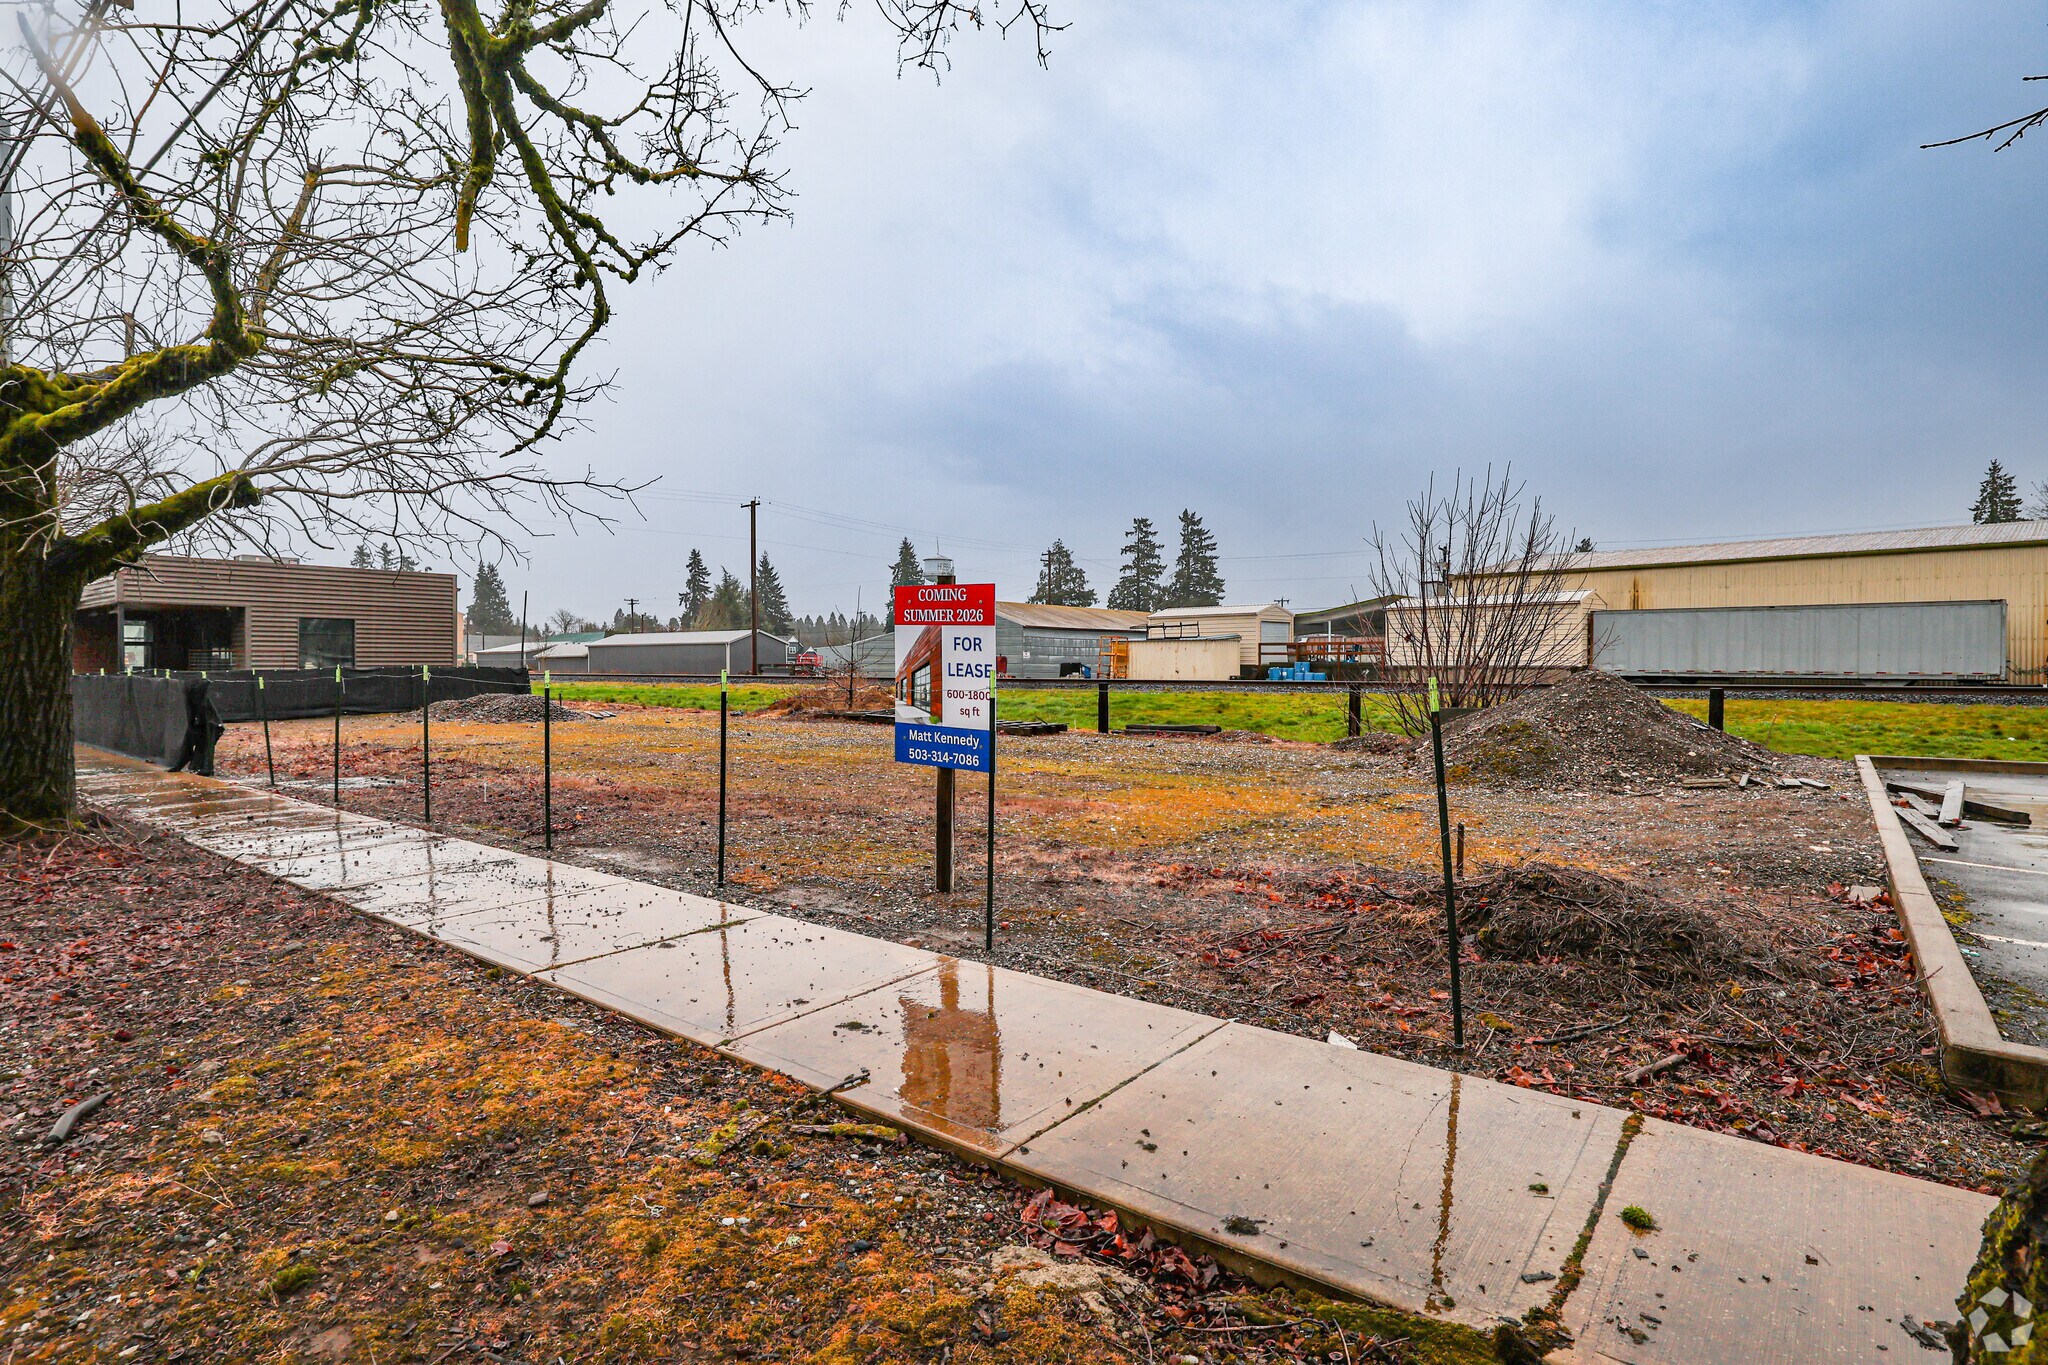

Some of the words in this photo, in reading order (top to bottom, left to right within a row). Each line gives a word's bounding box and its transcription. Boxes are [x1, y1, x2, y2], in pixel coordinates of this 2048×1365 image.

[918, 588, 967, 601] COMING
[903, 609, 955, 622] SUMMER
[956, 608, 984, 622] 2026
[953, 637, 982, 651] FOR
[948, 662, 993, 678] LEASE
[959, 707, 970, 718] sq
[972, 706, 981, 717] ft
[909, 729, 932, 742] Matt
[934, 731, 980, 750] Kennedy
[908, 748, 980, 767] 503-314-7086
